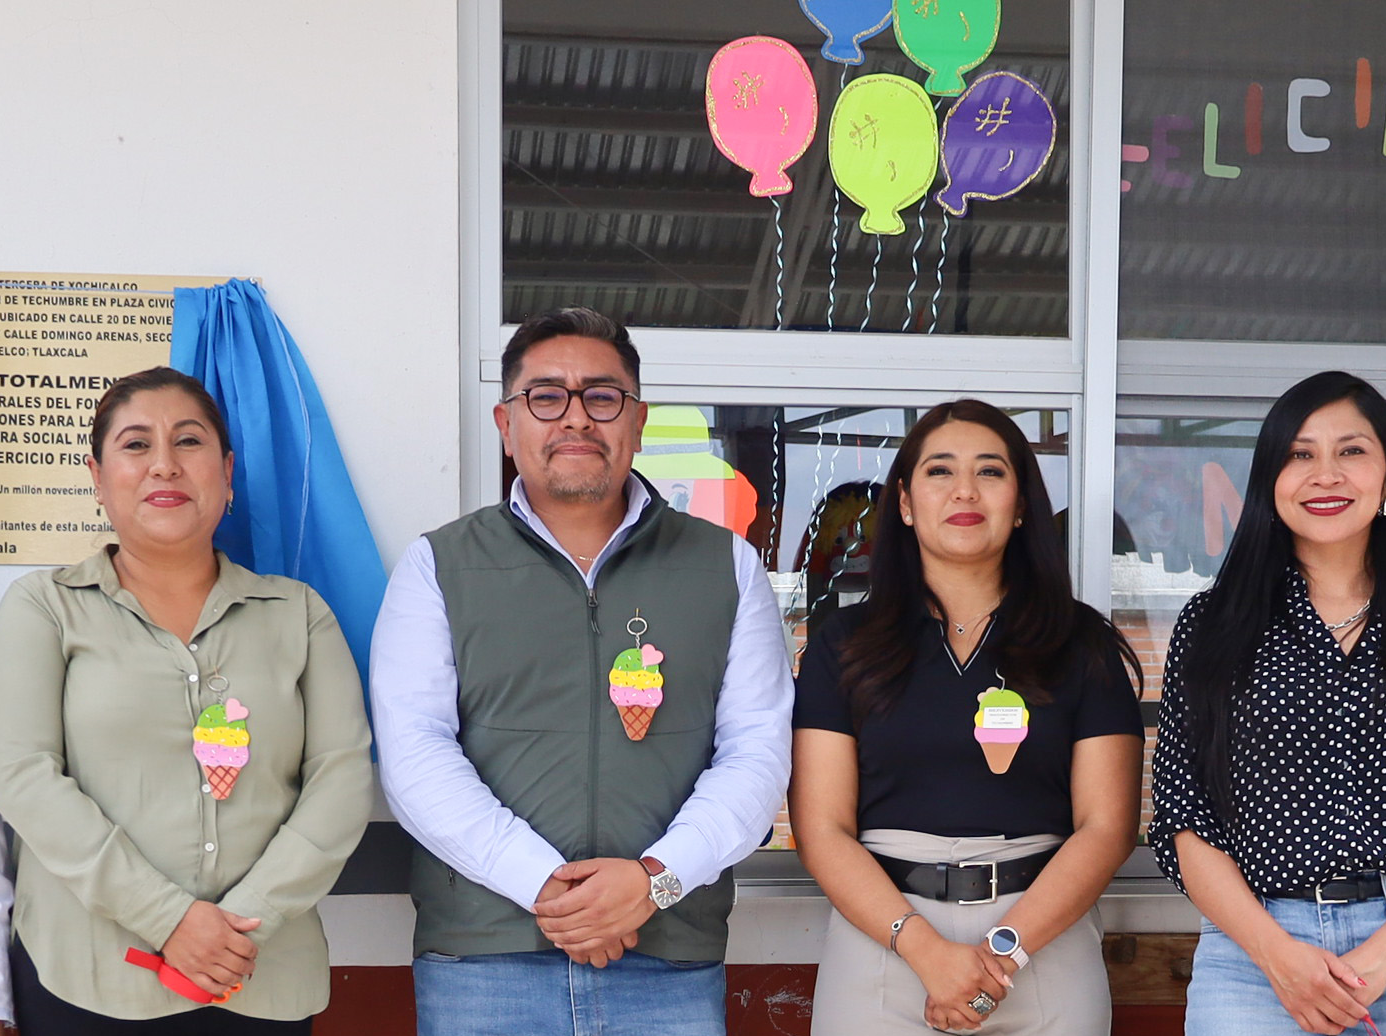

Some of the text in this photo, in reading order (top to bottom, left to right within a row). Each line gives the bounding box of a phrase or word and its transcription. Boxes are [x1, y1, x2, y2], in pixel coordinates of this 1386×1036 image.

[51, 281, 65, 290] DE
[68, 282, 138, 292] XOCHICALCO
[4, 296, 18, 306] DE
[22, 296, 88, 306] TECHUMBRE
[92, 297, 106, 307] EN
[110, 298, 145, 308] PLAZA
[52, 313, 66, 323] EN
[69, 314, 104, 324] CALLE
[107, 315, 119, 324] 20
[122, 315, 136, 325] DE
[140, 316, 173, 326] NOVIE
[4, 330, 38, 340] CALLE
[41, 330, 92, 340] DOMINGO
[96, 332, 142, 344] ARENAS,
[32, 347, 88, 358] TLAXCALA
[46, 396, 72, 409] DEL
[40, 414, 74, 427] PARA
[23, 431, 72, 445] SOCIAL
[40, 521, 52, 532] de
[56, 522, 78, 532] esta
